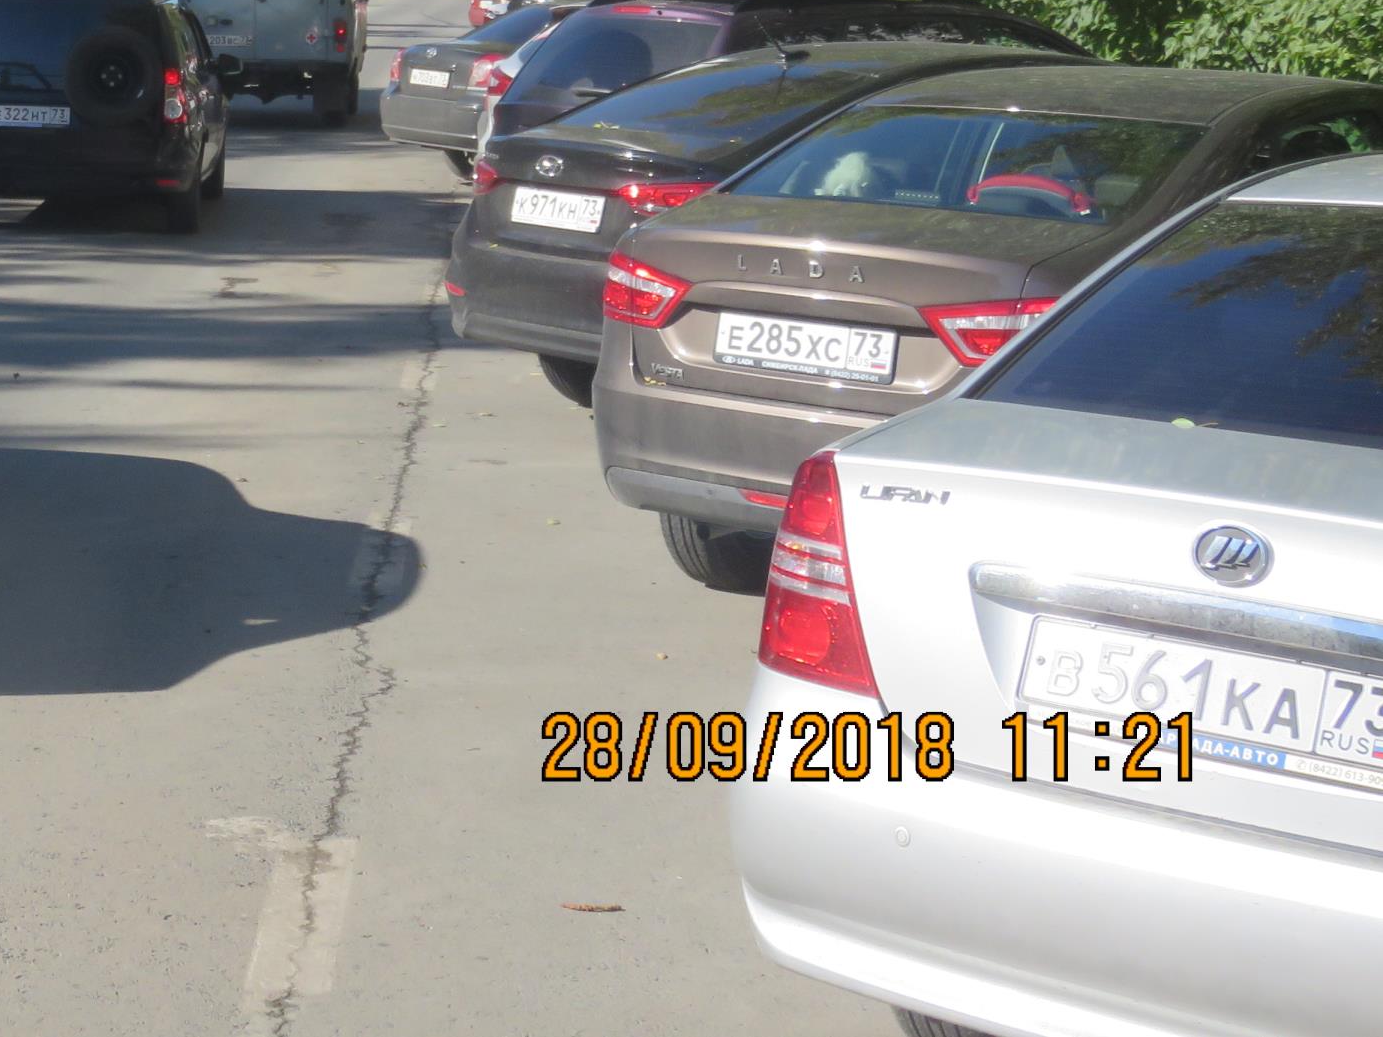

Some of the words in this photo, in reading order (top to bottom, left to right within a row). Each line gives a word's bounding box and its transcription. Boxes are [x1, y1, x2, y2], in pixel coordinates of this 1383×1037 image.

[51, 108, 66, 119] 73
[519, 194, 577, 219] К971КН
[581, 198, 598, 216] 73
[737, 254, 865, 283] LADA
[727, 321, 842, 362] Е285ХС
[853, 331, 884, 358] 73
[848, 356, 870, 368] RUS
[1046, 642, 1301, 740] В561КА
[1159, 732, 1280, 766] АРАДА-АВТО
[1320, 728, 1370, 756] RUS
